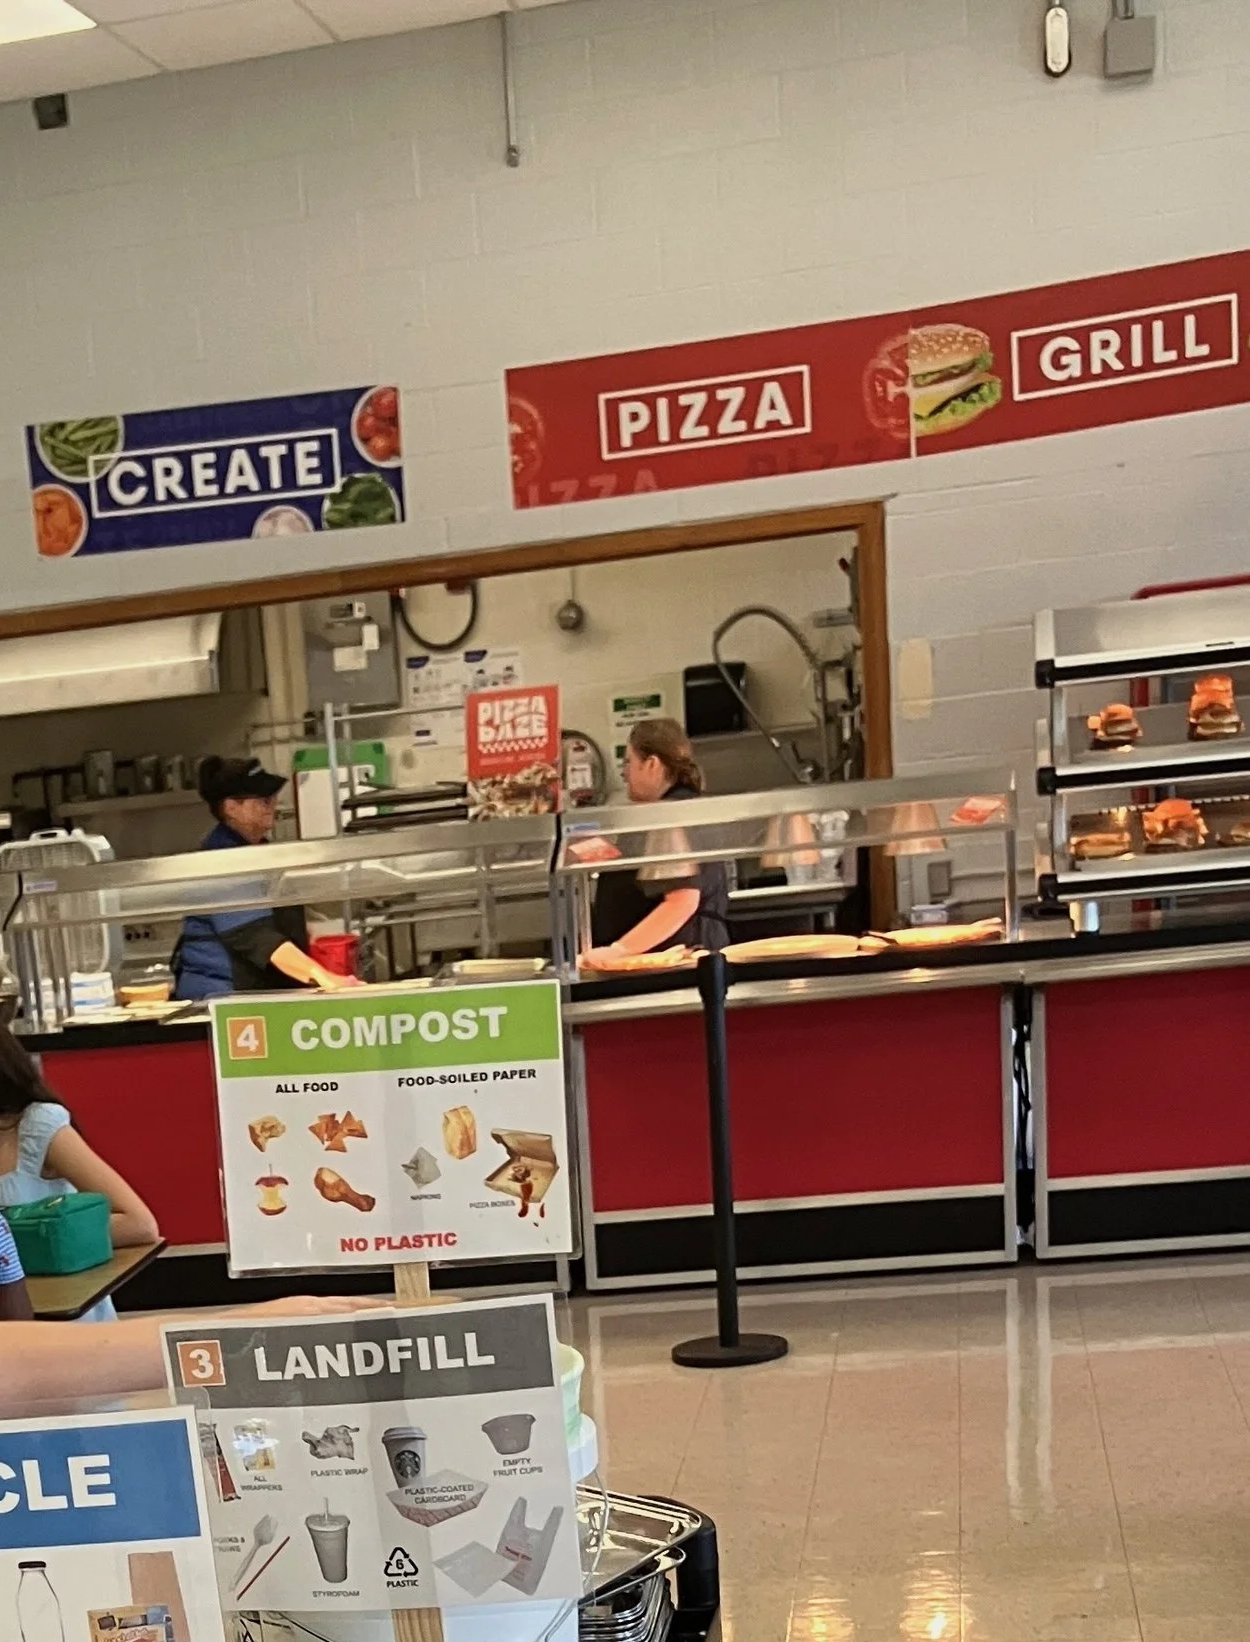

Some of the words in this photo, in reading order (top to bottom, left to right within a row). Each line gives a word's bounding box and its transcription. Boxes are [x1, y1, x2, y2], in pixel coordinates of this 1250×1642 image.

[1038, 314, 1210, 384] GRILL
[617, 381, 793, 448] PIZZA
[106, 440, 324, 506] CREATE
[477, 695, 547, 726] PIZZA
[236, 1024, 259, 1051] 4
[290, 1006, 508, 1050] COMPOST
[397, 1072, 488, 1088] FOOD-SOILED
[493, 1069, 537, 1082] PAPER
[275, 1083, 299, 1094] ALL
[303, 1081, 339, 1093] FOOD
[340, 1236, 368, 1252] NO
[374, 1232, 458, 1251] PLASTIC
[188, 1348, 214, 1379] 3
[253, 1332, 496, 1381] LANDFILL
[502, 1458, 532, 1467] EMPTY
[310, 1469, 343, 1477] PLASTIC
[344, 1468, 369, 1476] WRAP
[493, 1468, 518, 1477] FRUIT
[519, 1466, 544, 1475] CUPS
[405, 1484, 475, 1496] PLASTIC-COATED
[395, 1559, 405, 1570] 6
[386, 1579, 419, 1588] PLASTIC
[313, 1590, 360, 1598] STYROFOAM
